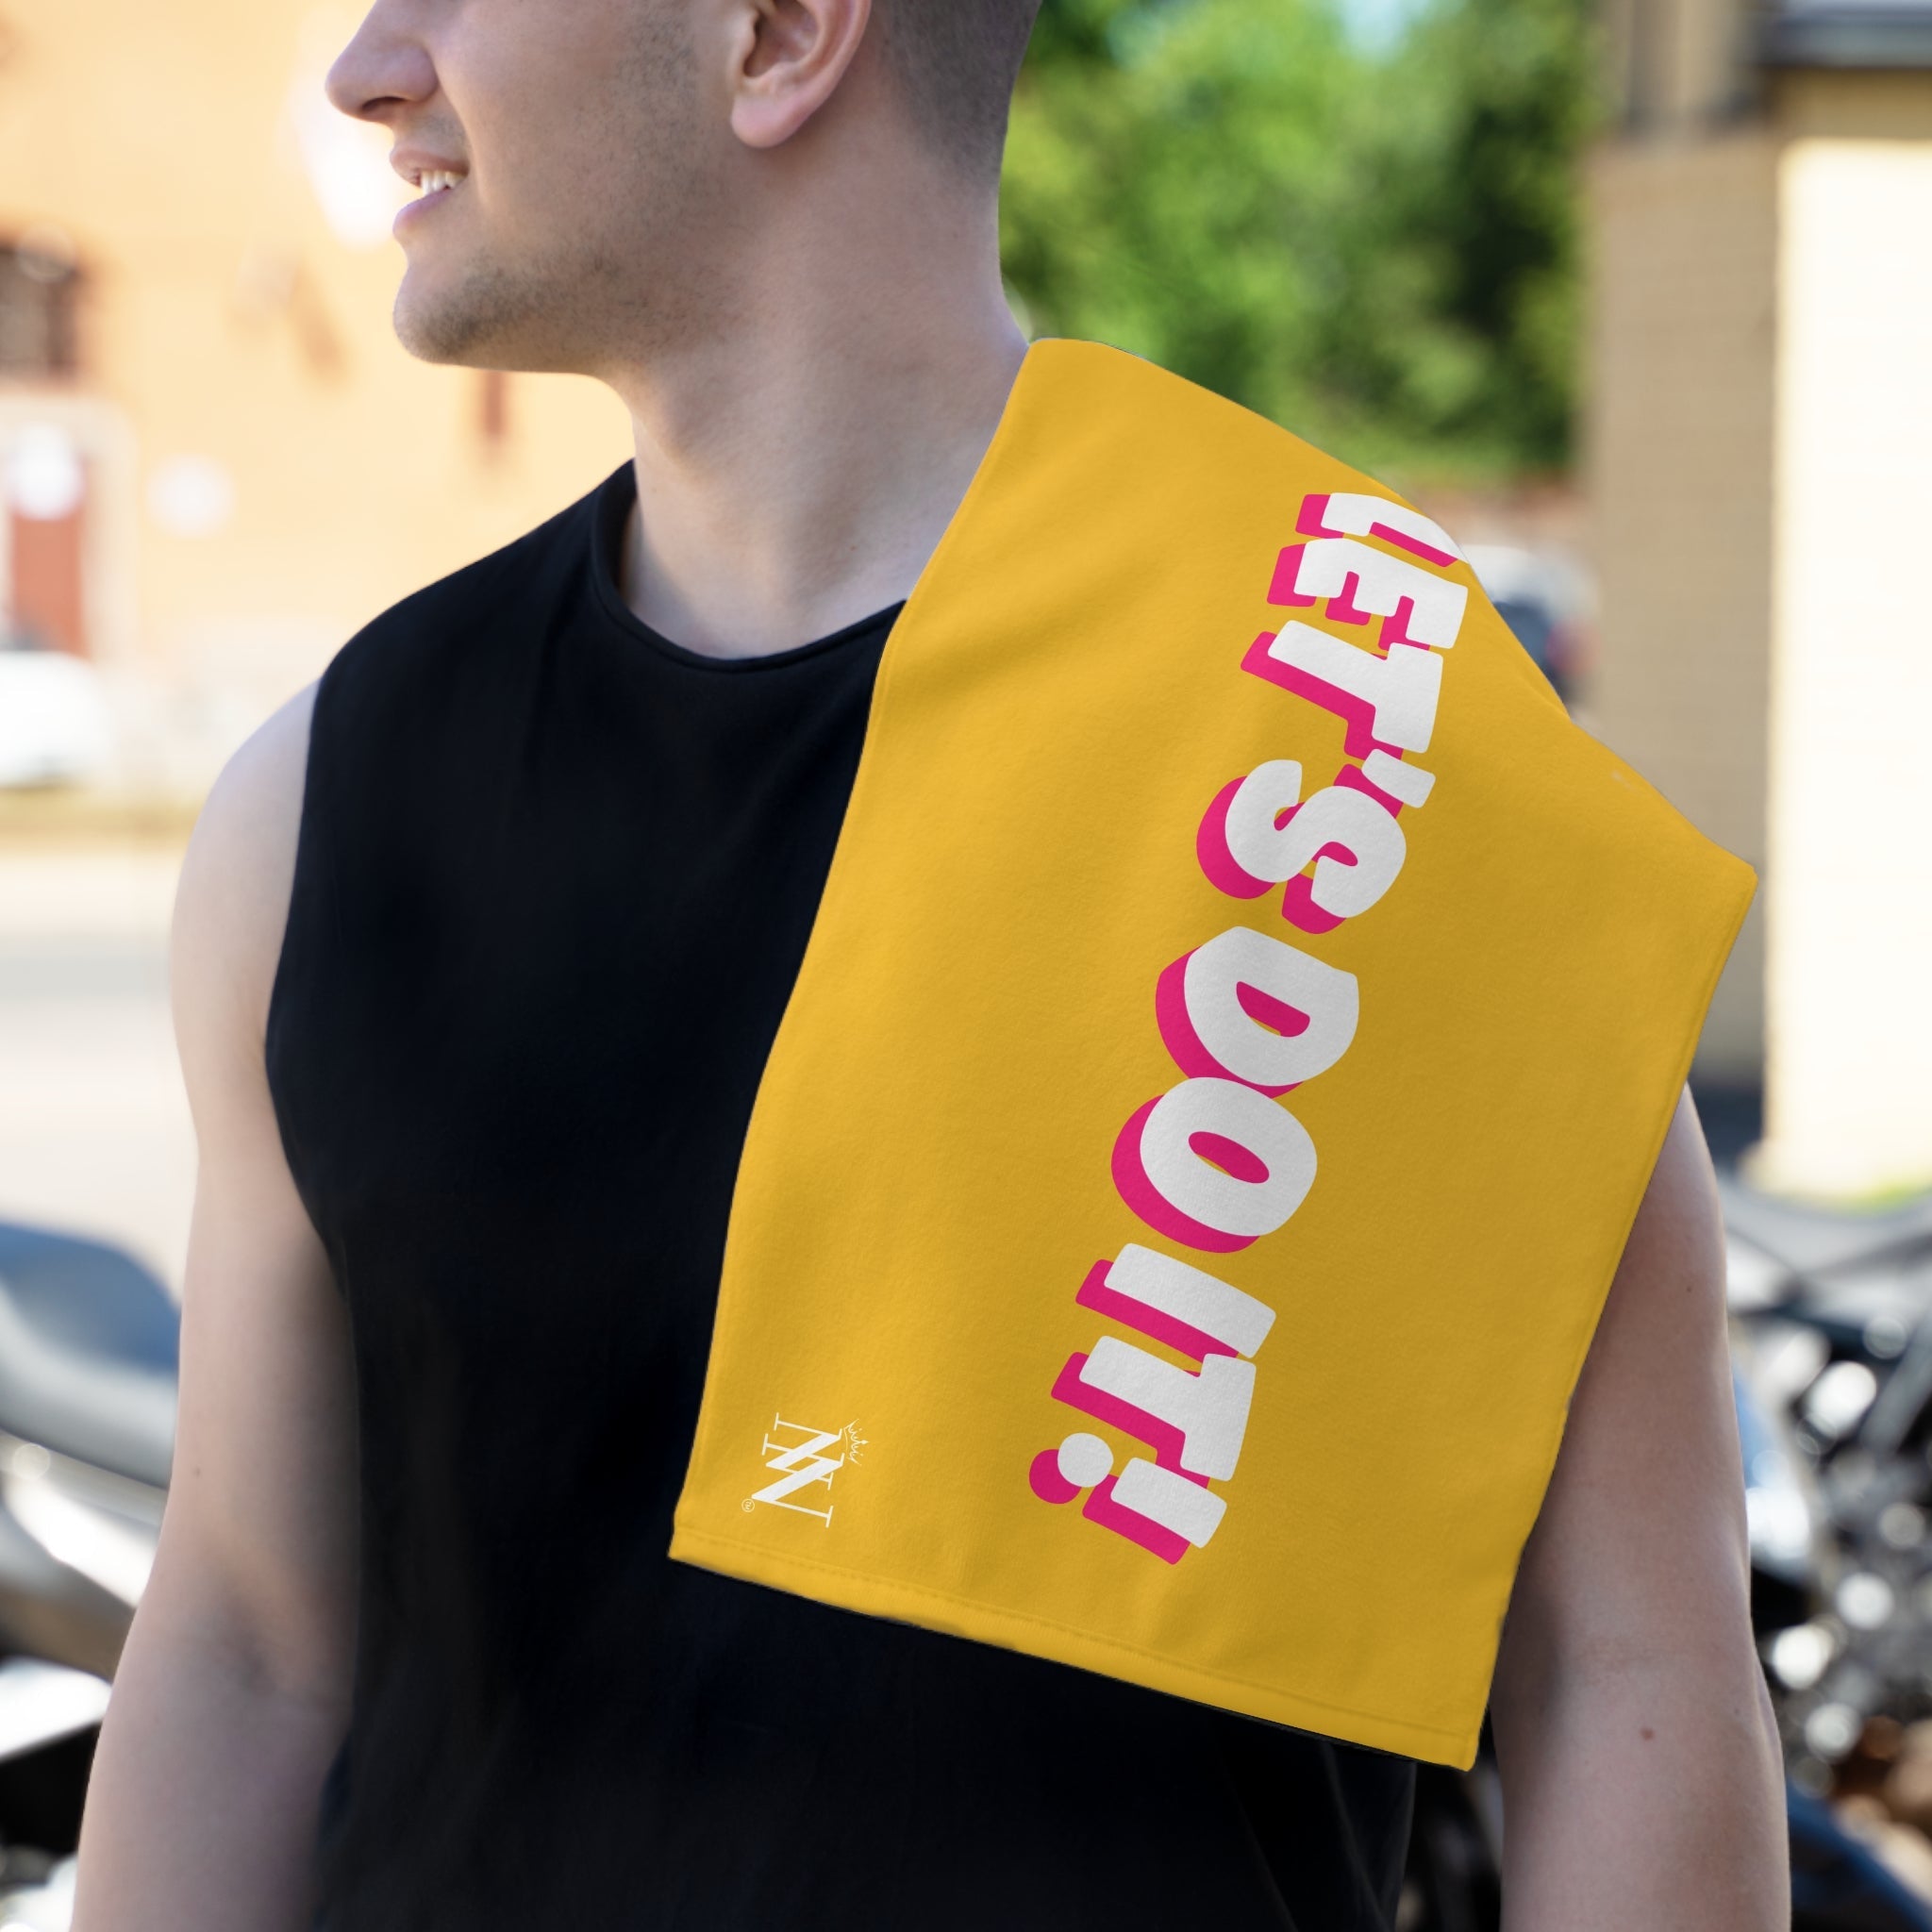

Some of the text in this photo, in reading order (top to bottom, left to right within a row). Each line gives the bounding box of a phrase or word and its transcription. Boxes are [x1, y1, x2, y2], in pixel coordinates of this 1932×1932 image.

[1031, 491, 1469, 1564] LET'S DO IT!
